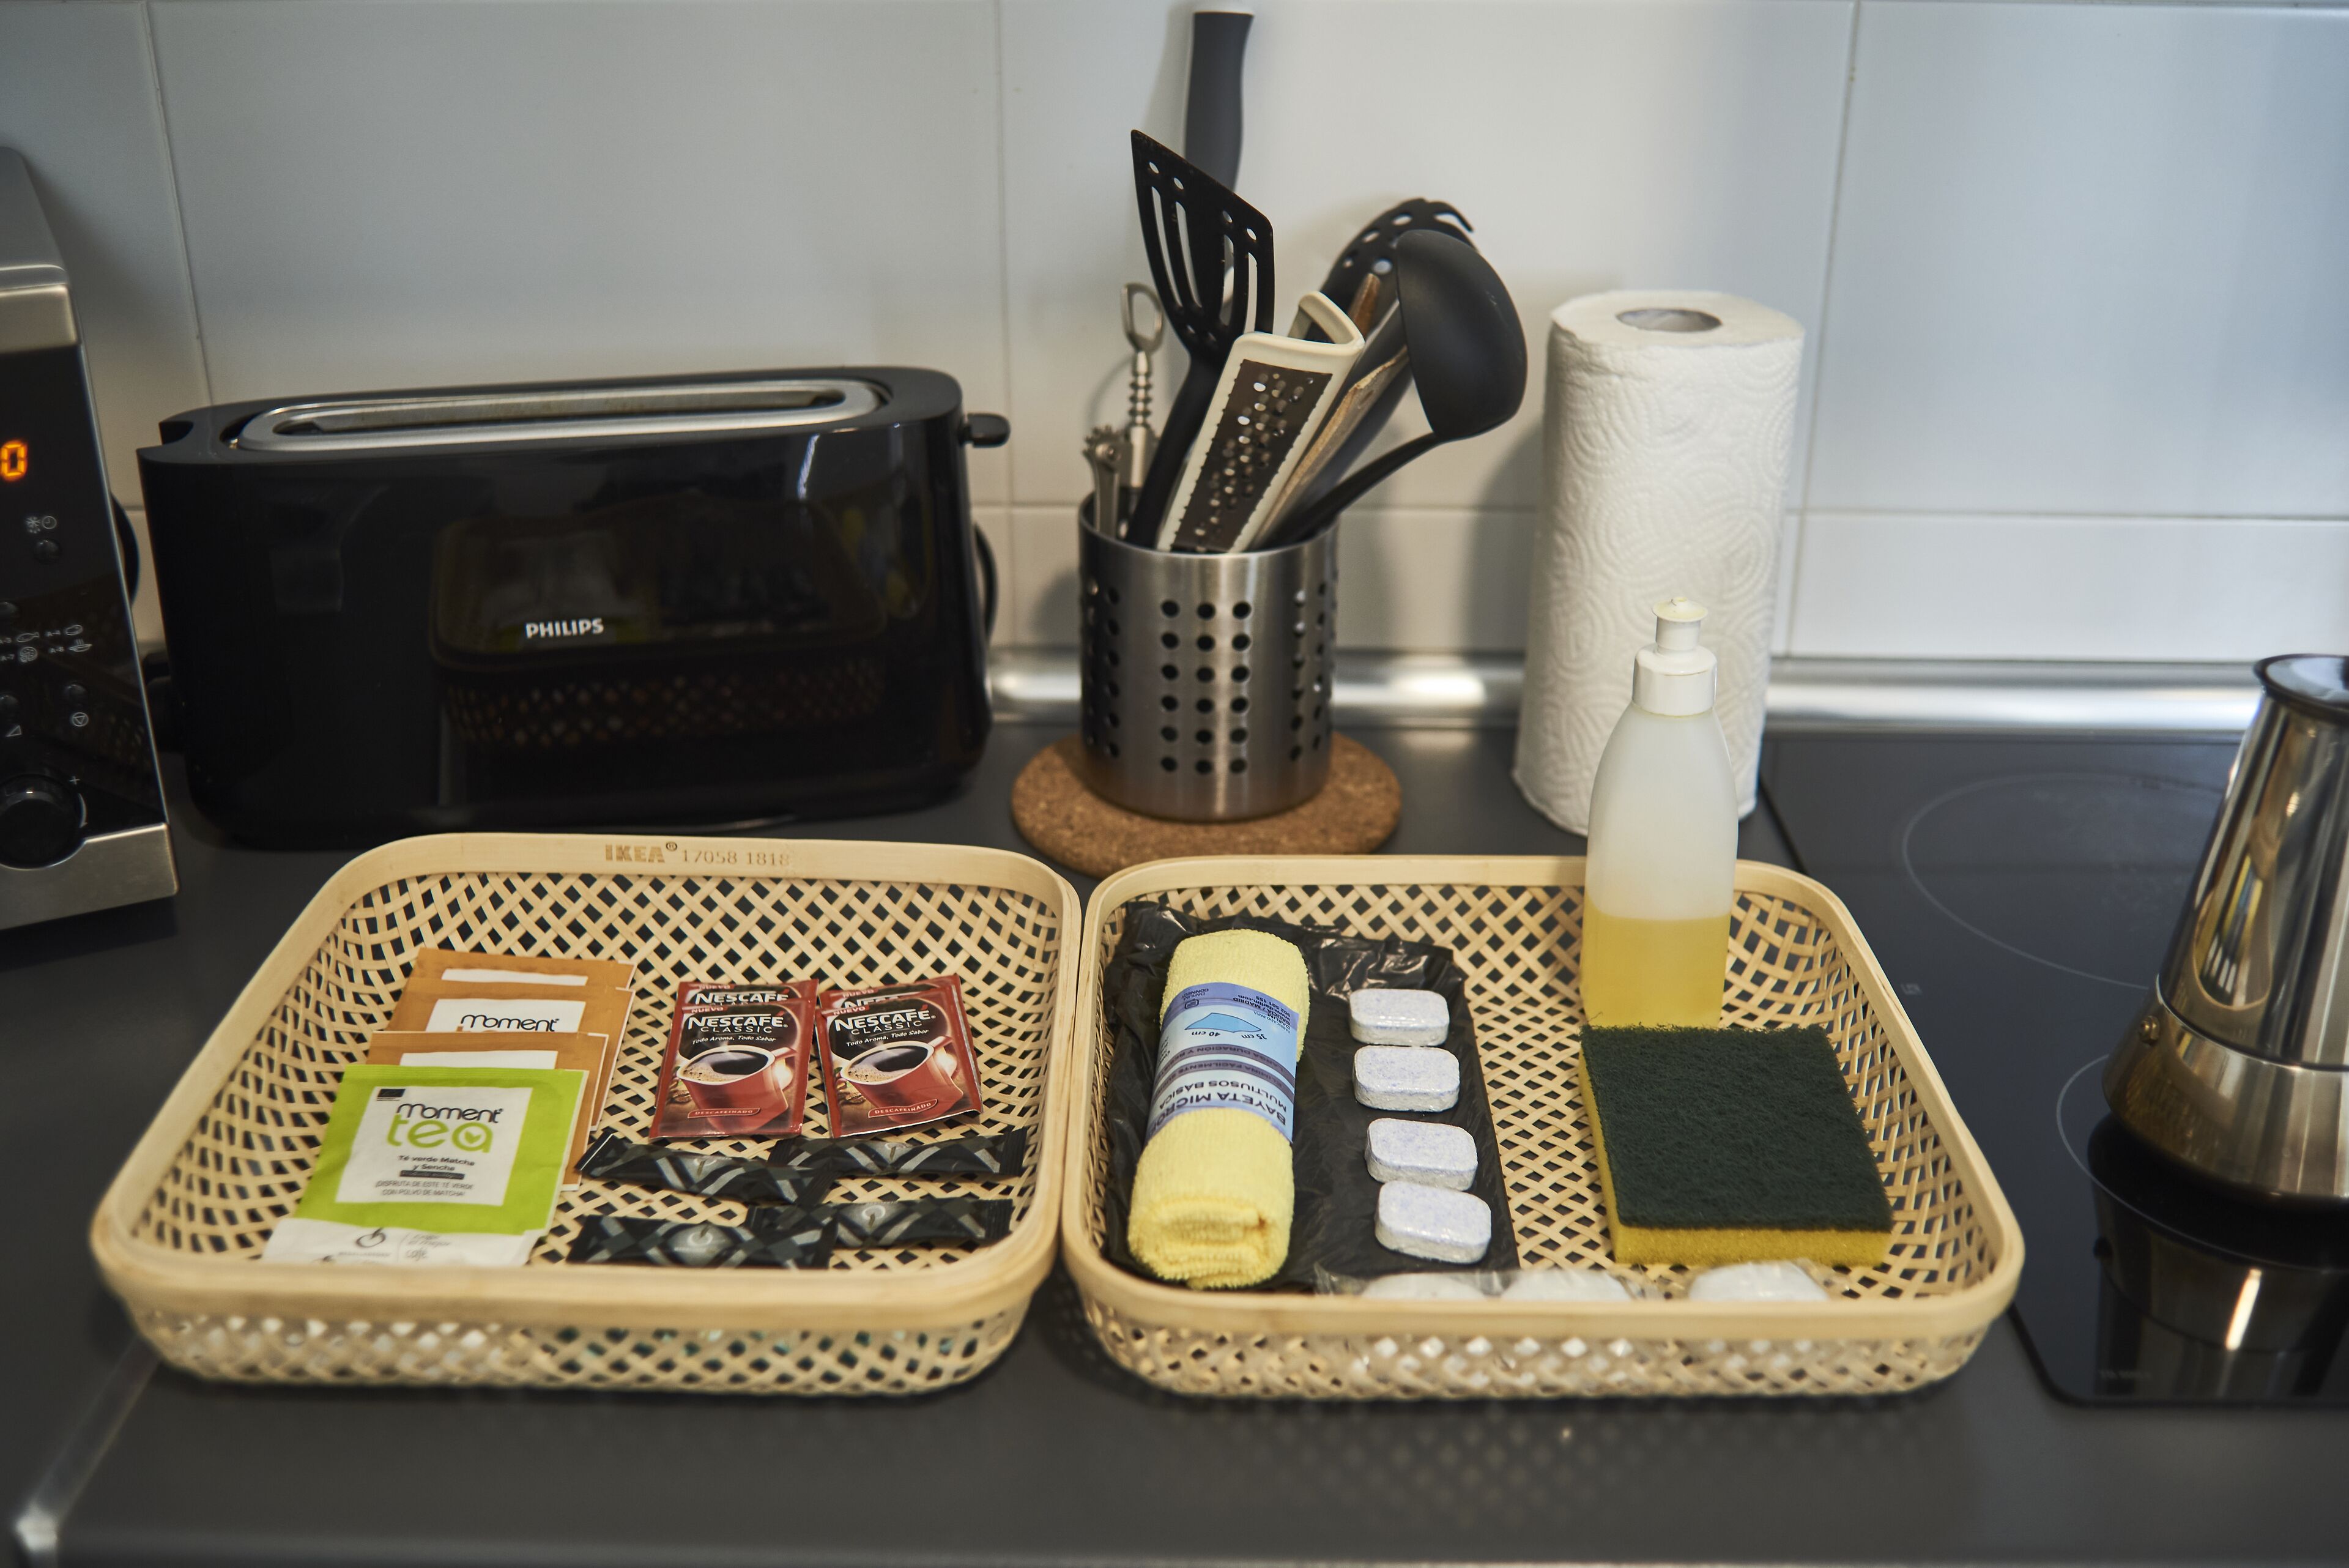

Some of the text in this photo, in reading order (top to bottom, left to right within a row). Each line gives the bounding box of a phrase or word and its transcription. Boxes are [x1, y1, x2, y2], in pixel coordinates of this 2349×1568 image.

[525, 617, 604, 638] PHILIPS
[682, 850, 738, 864] 17058
[833, 1006, 866, 1016] NUEVO
[1233, 997, 1260, 1009] MADRID
[1238, 994, 1291, 1022] www.darlim.com
[460, 1014, 556, 1032] moment
[1253, 1010, 1266, 1019] PARA
[1267, 1008, 1291, 1025] GALICIA
[1267, 1013, 1290, 1030] DARLIM
[851, 1020, 922, 1035] CLASSIC
[864, 1035, 889, 1044] Aroma,
[1208, 1080, 1286, 1112] MULTIUSOS
[396, 1103, 500, 1123] moment
[874, 1102, 931, 1114] DESCAFEINADO
[1217, 1093, 1286, 1126] BAYETA
[387, 1113, 493, 1153] tea
